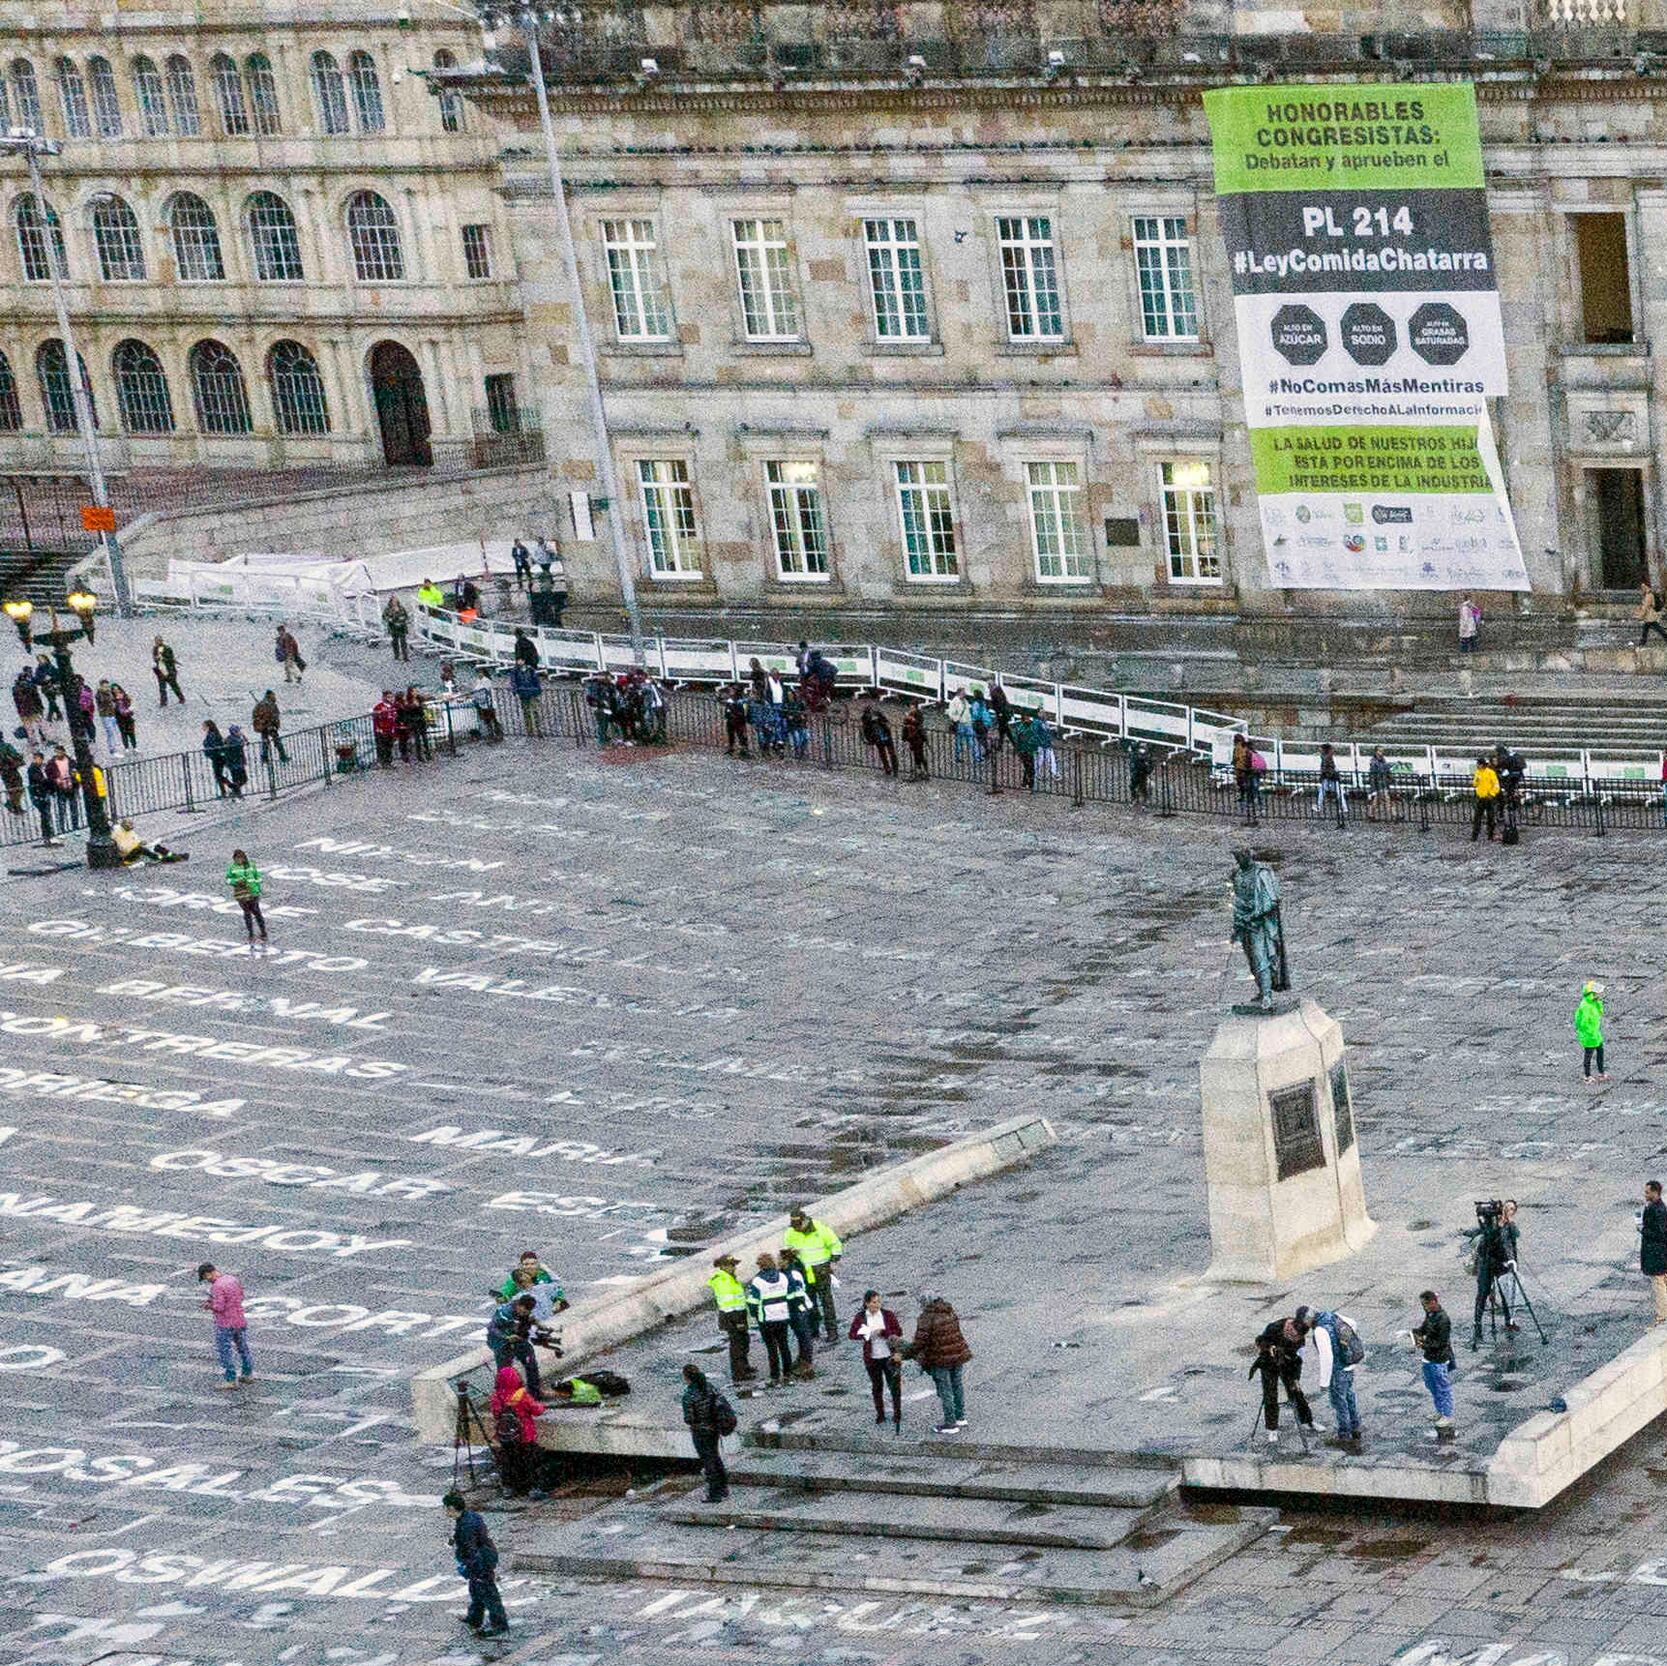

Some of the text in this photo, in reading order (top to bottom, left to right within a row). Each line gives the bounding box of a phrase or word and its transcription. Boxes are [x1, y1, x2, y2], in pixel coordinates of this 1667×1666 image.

[1267, 101, 1424, 123] HONORABLES
[1256, 124, 1441, 147] CONGRESISTAS:
[1245, 150, 1450, 171] Debatan y aprueben el
[1302, 206, 1414, 237] PL 214
[1233, 247, 1488, 277] #LeyComidaChatarra
[1351, 334, 1386, 346] SODIO
[1269, 378, 1485, 394] #NoComasMásMentiras
[1273, 438, 1292, 451] LA
[1300, 437, 1342, 451] SALUD
[1350, 437, 1366, 451] DE
[1371, 436, 1446, 451] NUESTROS
[1333, 456, 1364, 469] POR
[1368, 456, 1422, 470] ENCIMA
[1428, 455, 1447, 469] DE
[1451, 455, 1480, 469] LOS
[1290, 473, 1493, 489] INTERESES DE LA INDUSTRIA
[150, 1149, 451, 1201] OSCAR
